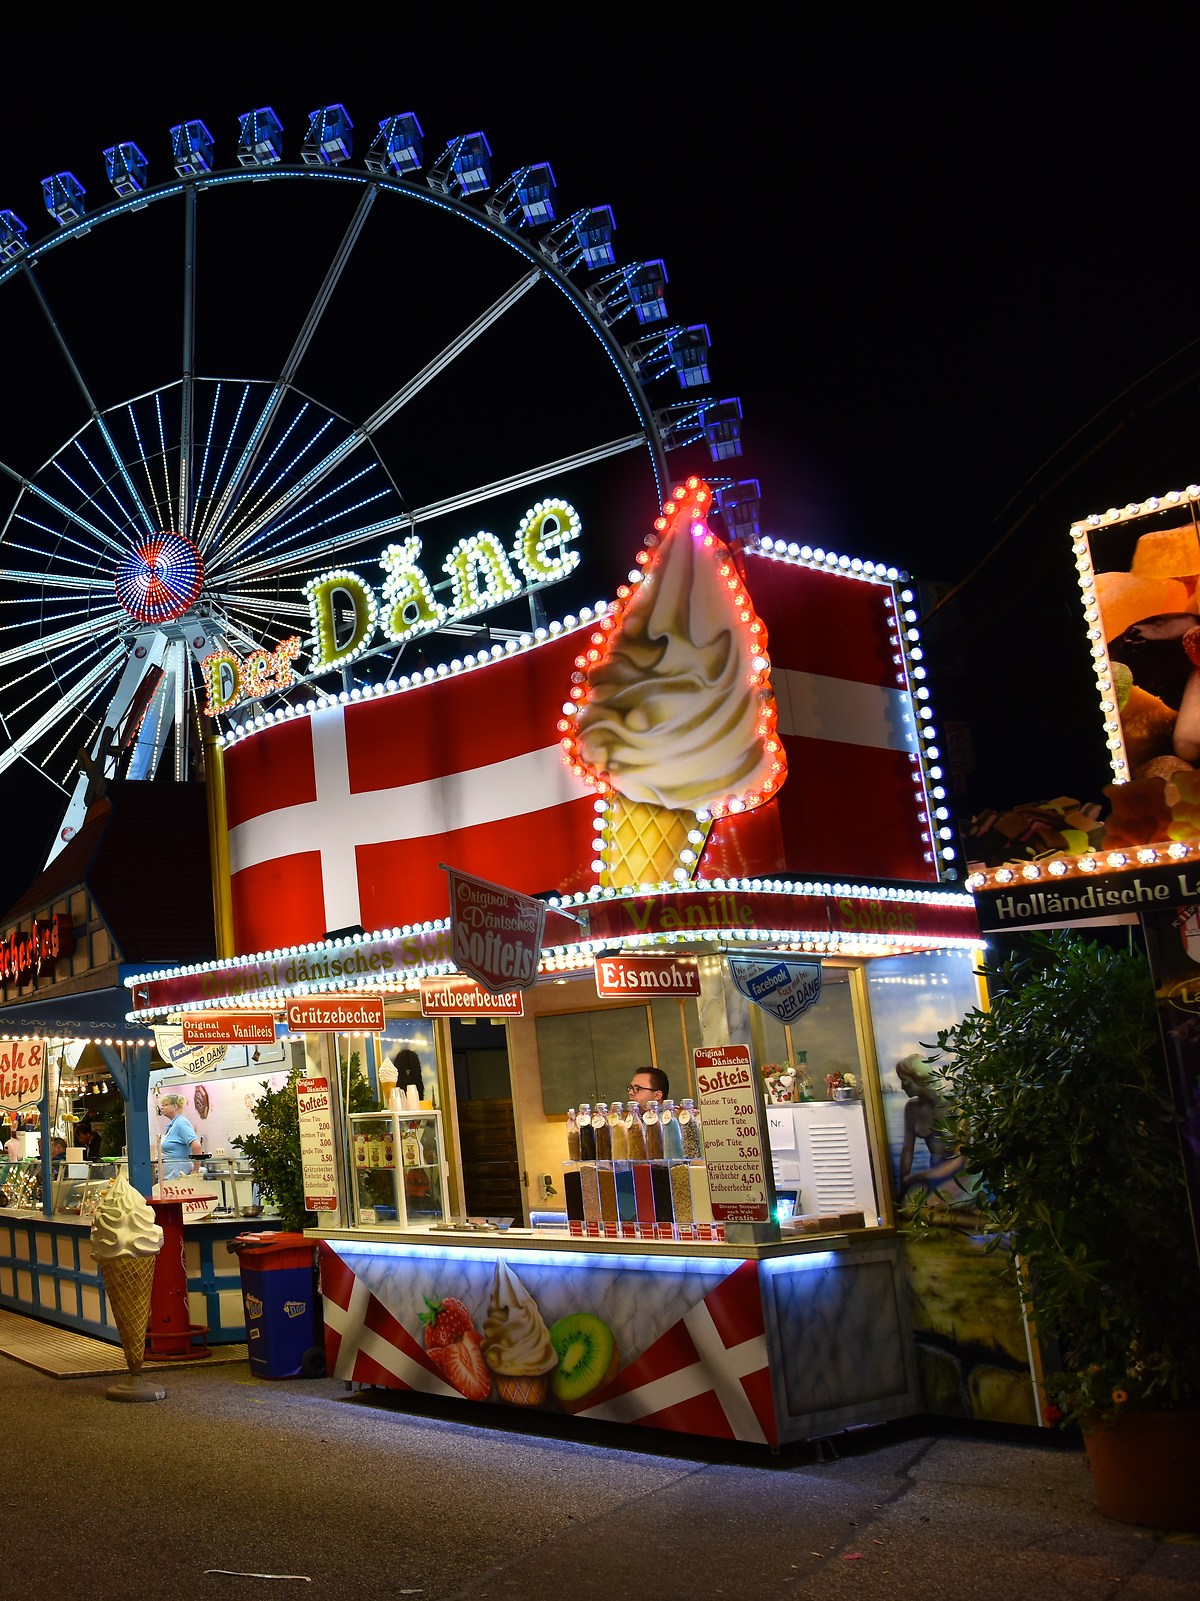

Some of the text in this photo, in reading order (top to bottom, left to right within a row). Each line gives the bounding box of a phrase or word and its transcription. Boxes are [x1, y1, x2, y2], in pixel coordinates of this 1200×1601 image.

[201, 498, 581, 717] Der Däne
[458, 883, 509, 908] Original
[995, 878, 1171, 920] Holländische
[463, 906, 535, 933] Dänisches
[622, 895, 917, 931] Vanille Softeis
[457, 921, 533, 979] Softeis
[203, 964, 279, 997] Original
[286, 949, 395, 984] dänisches
[601, 962, 695, 989] Eismohr
[752, 969, 788, 996] facebook
[425, 987, 518, 1008] Erdbeerbecher
[777, 978, 820, 1018] DER DÄNE
[289, 1006, 381, 1024] Grützebecher
[184, 1021, 219, 1030] Original
[188, 1030, 230, 1038] Dänisches
[232, 1024, 272, 1038] Vanilleeis
[28, 1045, 41, 1066] &
[696, 1048, 725, 1058] Original
[712, 1057, 749, 1066] Dänisches
[189, 1056, 206, 1073] DER
[698, 1067, 750, 1093] Softeis
[299, 1094, 328, 1114] Softeis
[734, 1105, 753, 1116] 2,00
[730, 1117, 746, 1125] Tüte
[770, 1119, 784, 1128] Nr.
[736, 1127, 756, 1138] 3,00
[704, 1138, 742, 1149] große Tüte
[739, 1147, 759, 1158] 3,50
[707, 1163, 759, 1171] Grützebecher
[709, 1172, 761, 1185] Kiwibecher 4,50
[162, 1186, 194, 1196] Bier
[710, 1183, 752, 1192] Erdbeerbecher
